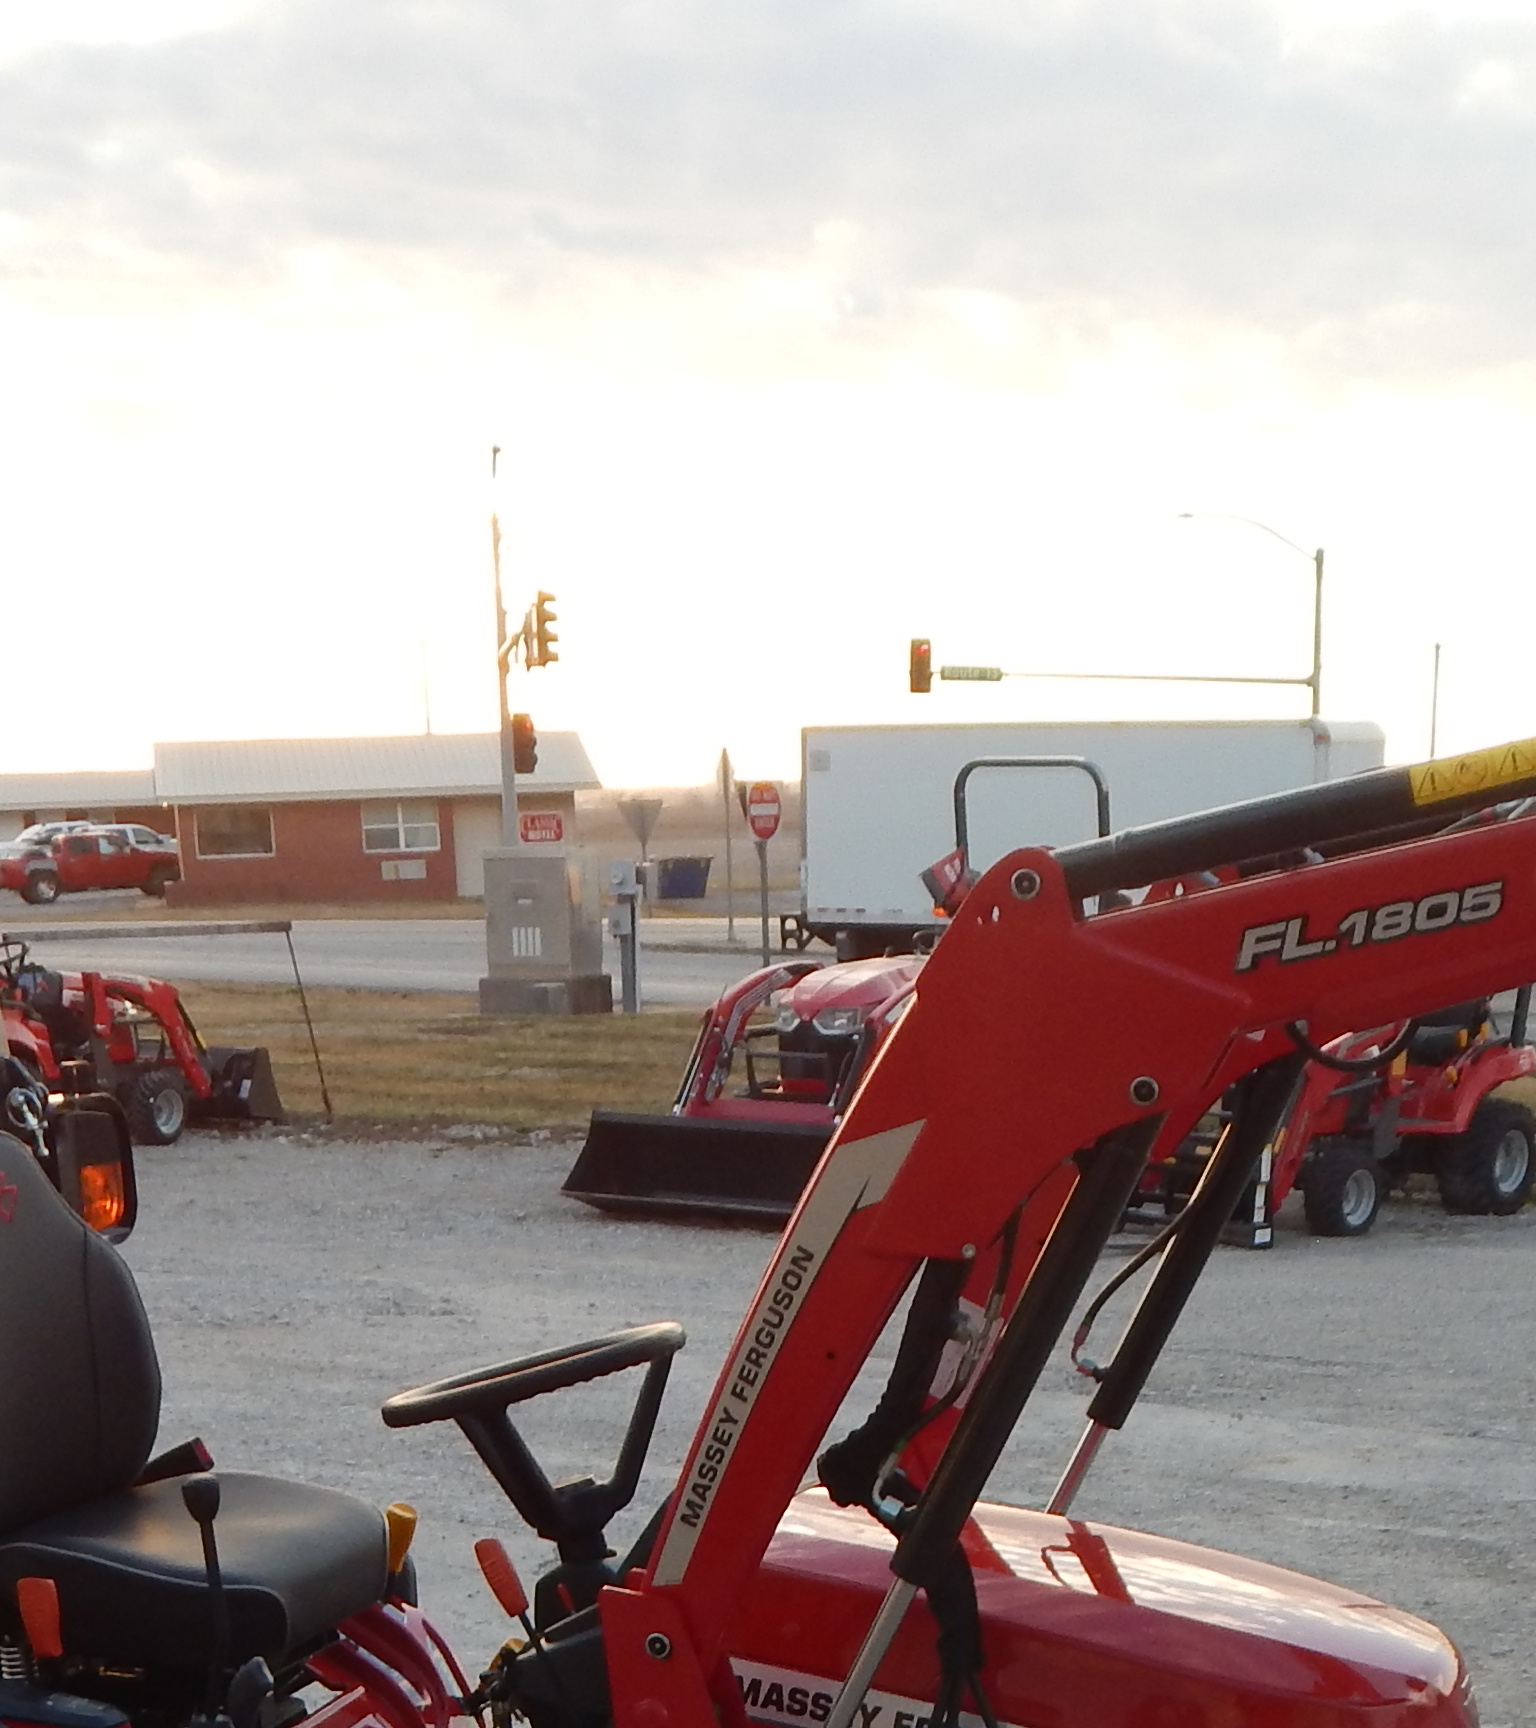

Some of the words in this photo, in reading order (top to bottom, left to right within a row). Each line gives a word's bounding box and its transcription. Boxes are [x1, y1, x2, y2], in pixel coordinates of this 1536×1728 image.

[1233, 880, 1504, 972] FL.1805
[680, 1406, 739, 1528] MASSEY
[730, 1245, 815, 1403] FERGUSON
